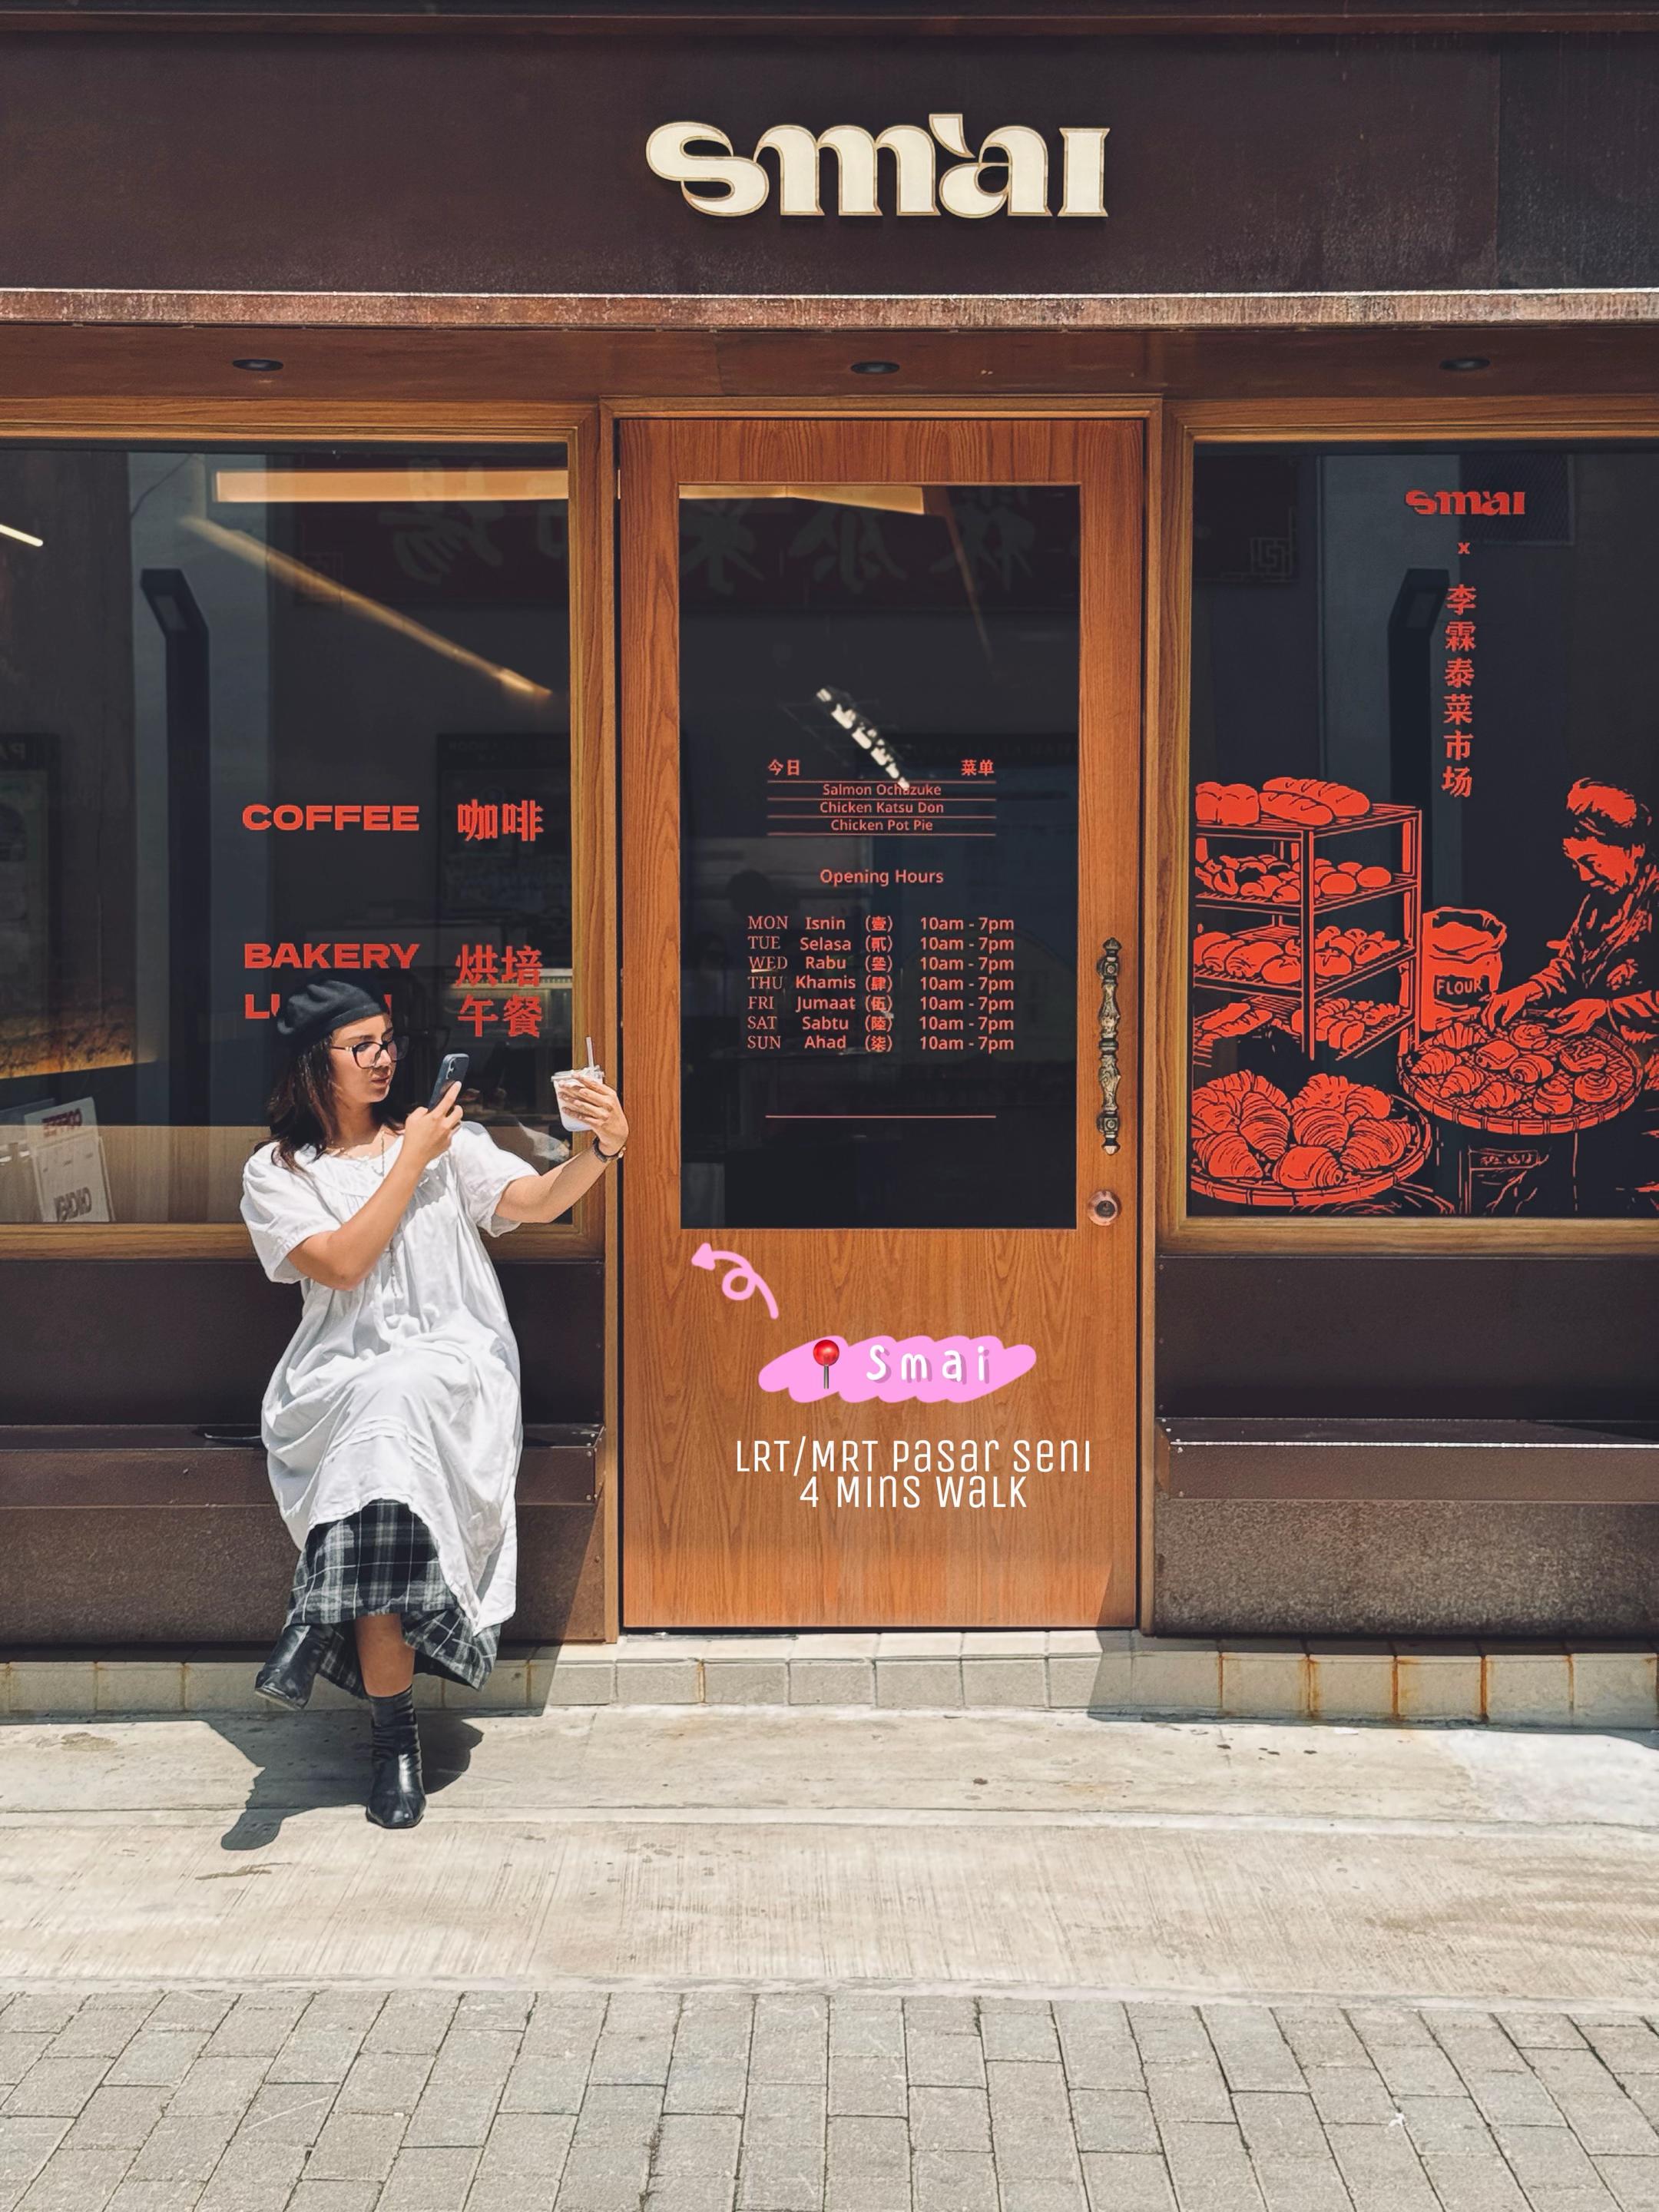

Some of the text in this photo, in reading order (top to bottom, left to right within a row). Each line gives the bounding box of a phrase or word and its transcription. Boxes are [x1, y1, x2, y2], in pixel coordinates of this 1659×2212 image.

[1441, 584, 1476, 798] 李霖泰菜市场
[768, 759, 994, 776] 今日 菜单
[823, 783, 942, 796] Salmon Ochazuke
[820, 801, 944, 813] Chicken Katsu Don
[242, 800, 544, 842] COFFEE 咖啡
[830, 819, 933, 831] Chicken Pot Pie
[820, 869, 944, 886] Opening Hours
[748, 916, 788, 930] MON
[805, 916, 846, 930] Isnin
[920, 917, 964, 931] 10am
[978, 917, 1015, 935] 7pm
[747, 935, 781, 949] TUE
[800, 937, 852, 951] Selasa
[920, 937, 964, 951] 10am
[978, 937, 1015, 955] 7pm
[243, 942, 420, 969] BAKERY
[748, 956, 788, 971] WED
[805, 955, 847, 969] Rabu
[920, 957, 964, 971] 10am
[978, 957, 1015, 975] 7pm
[747, 976, 783, 989] THU
[795, 975, 856, 989] Khamis
[920, 977, 964, 991] 10am
[978, 977, 1015, 995] 7pm
[1436, 979, 1483, 996] FLOUR
[747, 996, 775, 1010] FRI
[795, 996, 856, 1013] Jumaat
[920, 996, 964, 1010] 10am
[978, 996, 1015, 1014] 7pm
[457, 994, 543, 1038] 午餐
[747, 1016, 777, 1030] SAT
[802, 1015, 849, 1030] Sabtu
[920, 1016, 964, 1030] 10am
[978, 1016, 1015, 1034] 7pm
[747, 1035, 781, 1050] SUN
[804, 1035, 846, 1049] Ahad
[920, 1036, 964, 1050] 10am
[978, 1036, 1015, 1054] 7pm
